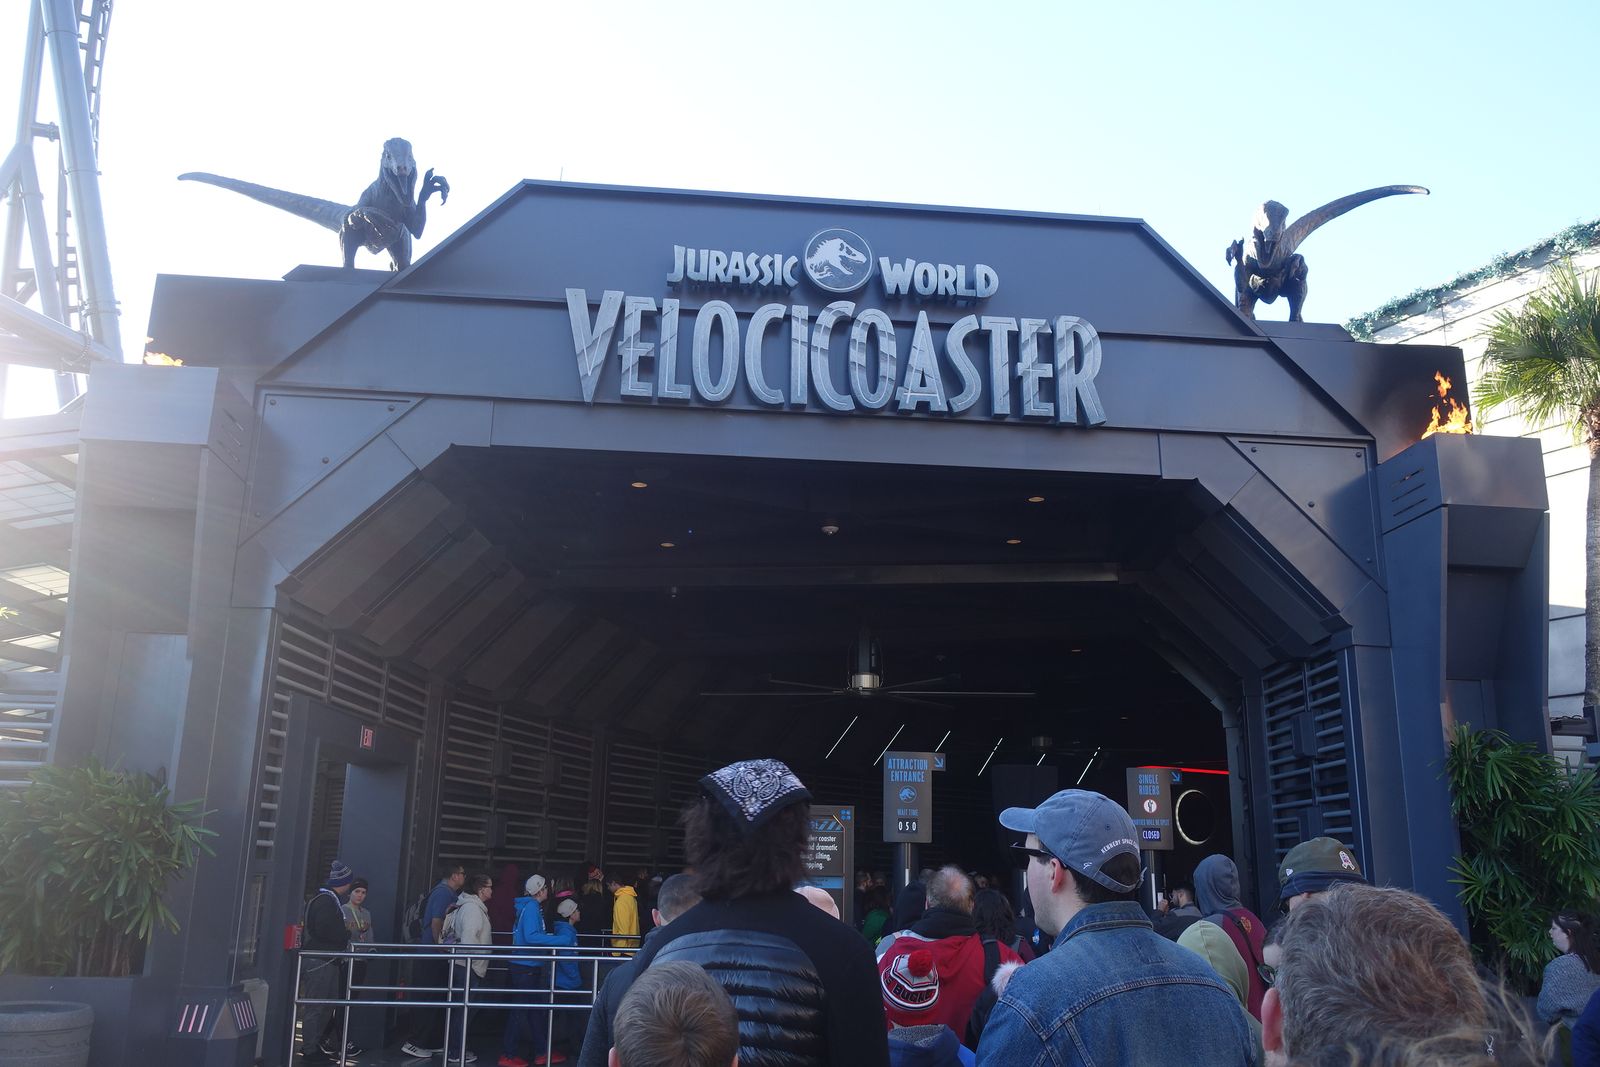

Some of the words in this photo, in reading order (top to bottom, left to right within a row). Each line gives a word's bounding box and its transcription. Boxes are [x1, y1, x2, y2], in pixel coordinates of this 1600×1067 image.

[667, 244, 798, 287] JURASSIC
[879, 256, 999, 298] WORLD
[565, 288, 1107, 428] VELOCICOASTER
[887, 758, 928, 770] ATTRACTION
[890, 770, 925, 783] ENTRANCE
[1138, 774, 1159, 785] SINGLE
[1138, 785, 1160, 796] RIDERS
[1142, 830, 1161, 840] CLOSED
[815, 843, 838, 851] dramatic
[1100, 840, 1121, 854] KENNEDY
